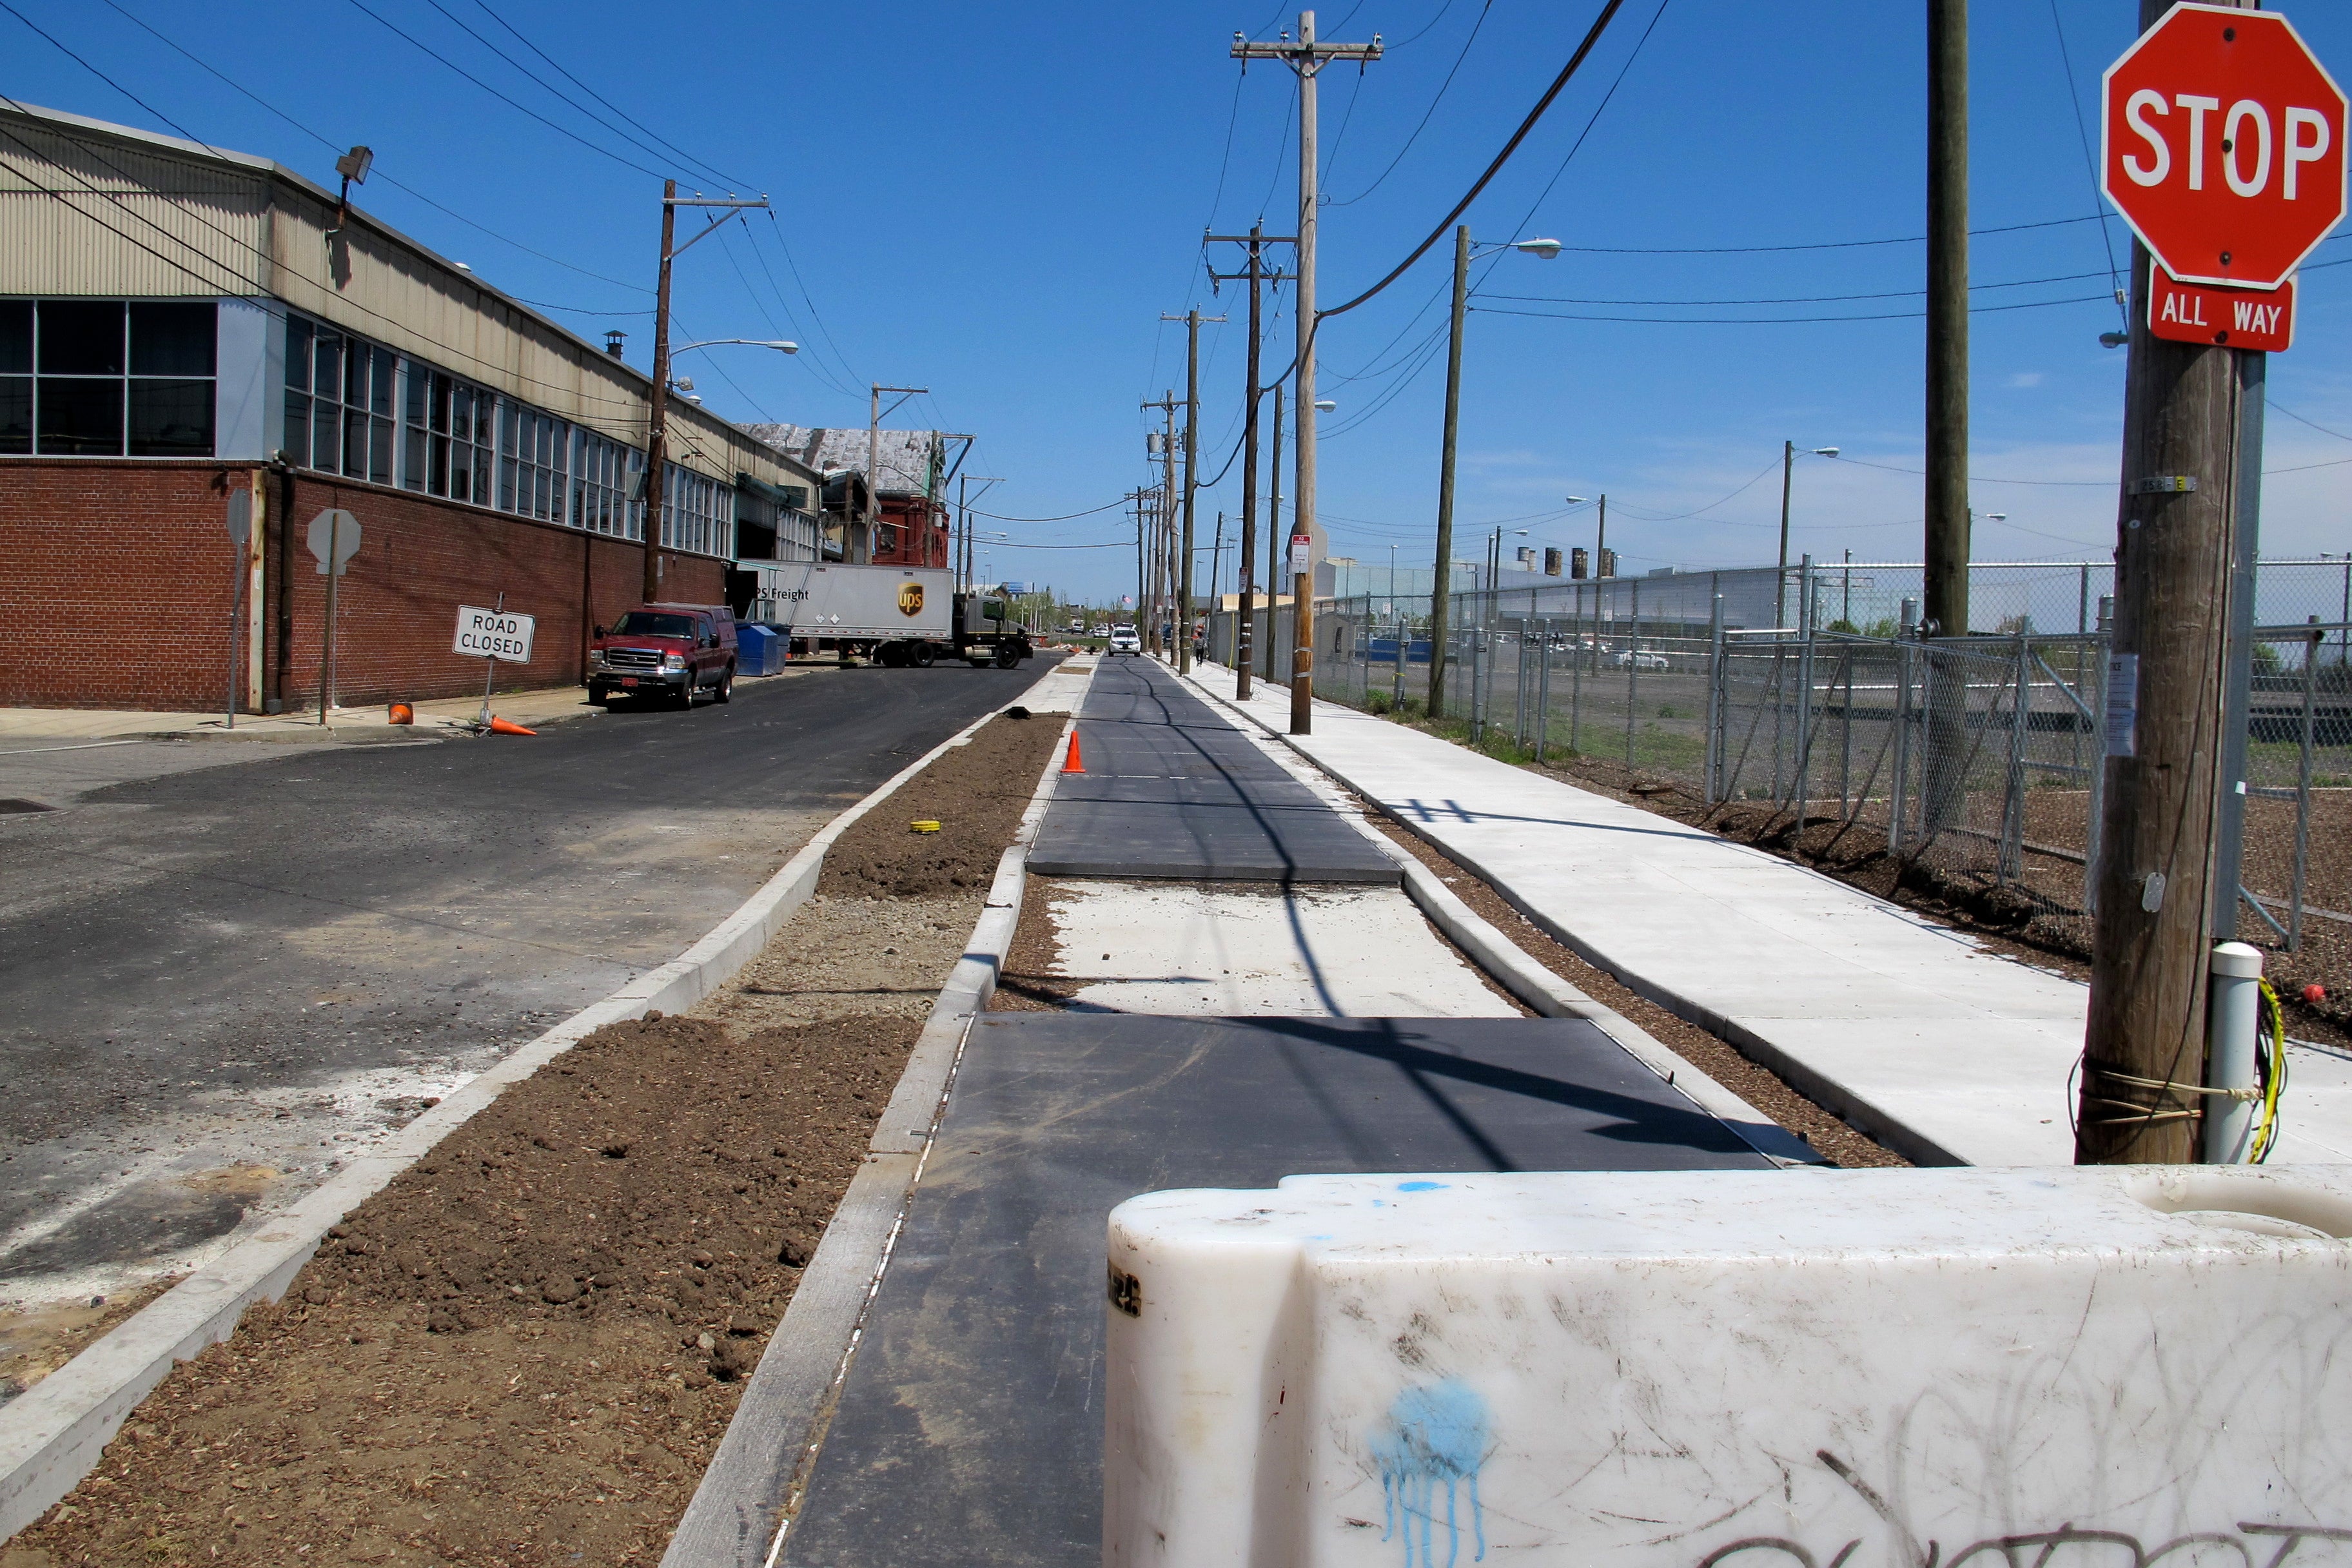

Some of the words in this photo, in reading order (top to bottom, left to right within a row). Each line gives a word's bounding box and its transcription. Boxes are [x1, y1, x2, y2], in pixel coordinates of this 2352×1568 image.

[2122, 88, 2330, 201] STOP
[2161, 292, 2208, 327] ALL
[2233, 300, 2282, 335] WAY
[757, 587, 767, 598] PS
[772, 588, 809, 603] Freight
[899, 593, 923, 612] ups
[473, 615, 517, 634] ROAD
[462, 633, 524, 654] CLOSED
